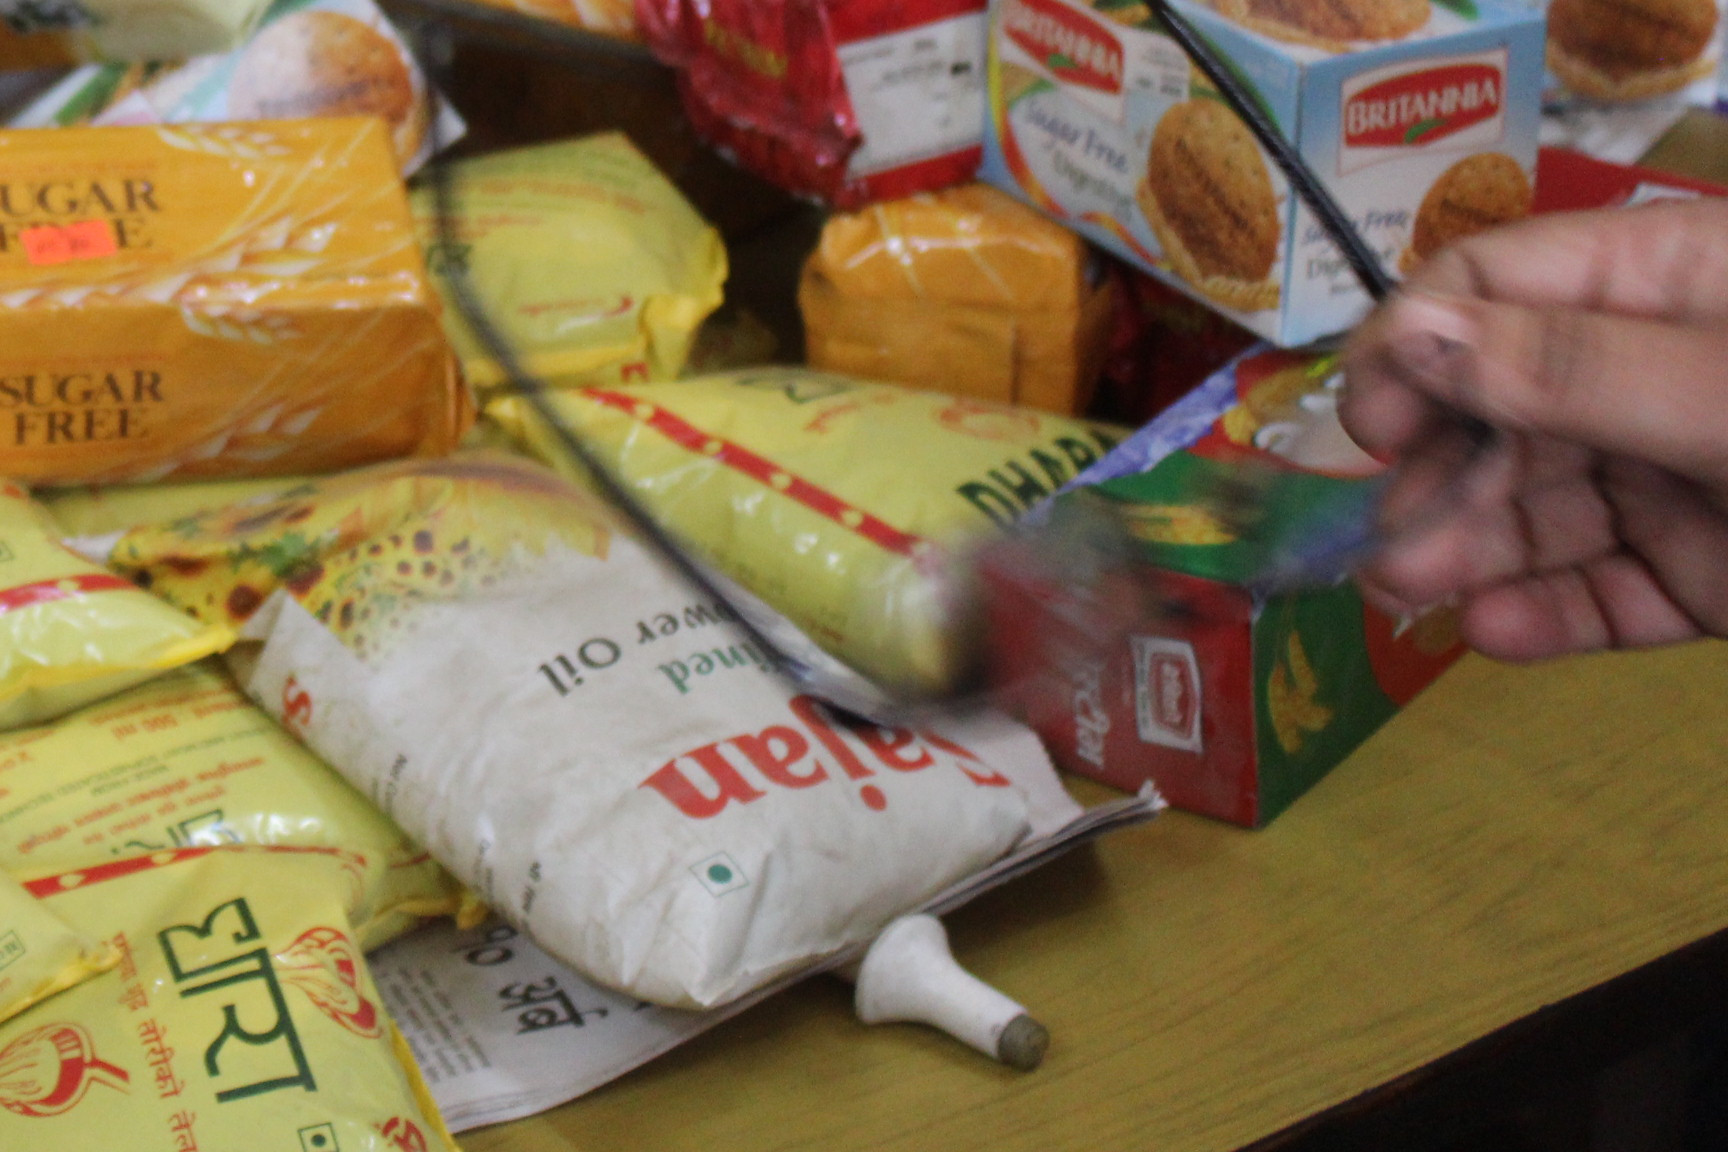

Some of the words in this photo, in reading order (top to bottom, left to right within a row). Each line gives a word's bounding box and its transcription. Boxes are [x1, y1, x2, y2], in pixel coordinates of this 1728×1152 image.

[1344, 76, 1499, 138] BRITANNIA
[13, 408, 148, 448] FREE
[537, 636, 622, 698] Oil
[157, 896, 319, 1105] धारा
